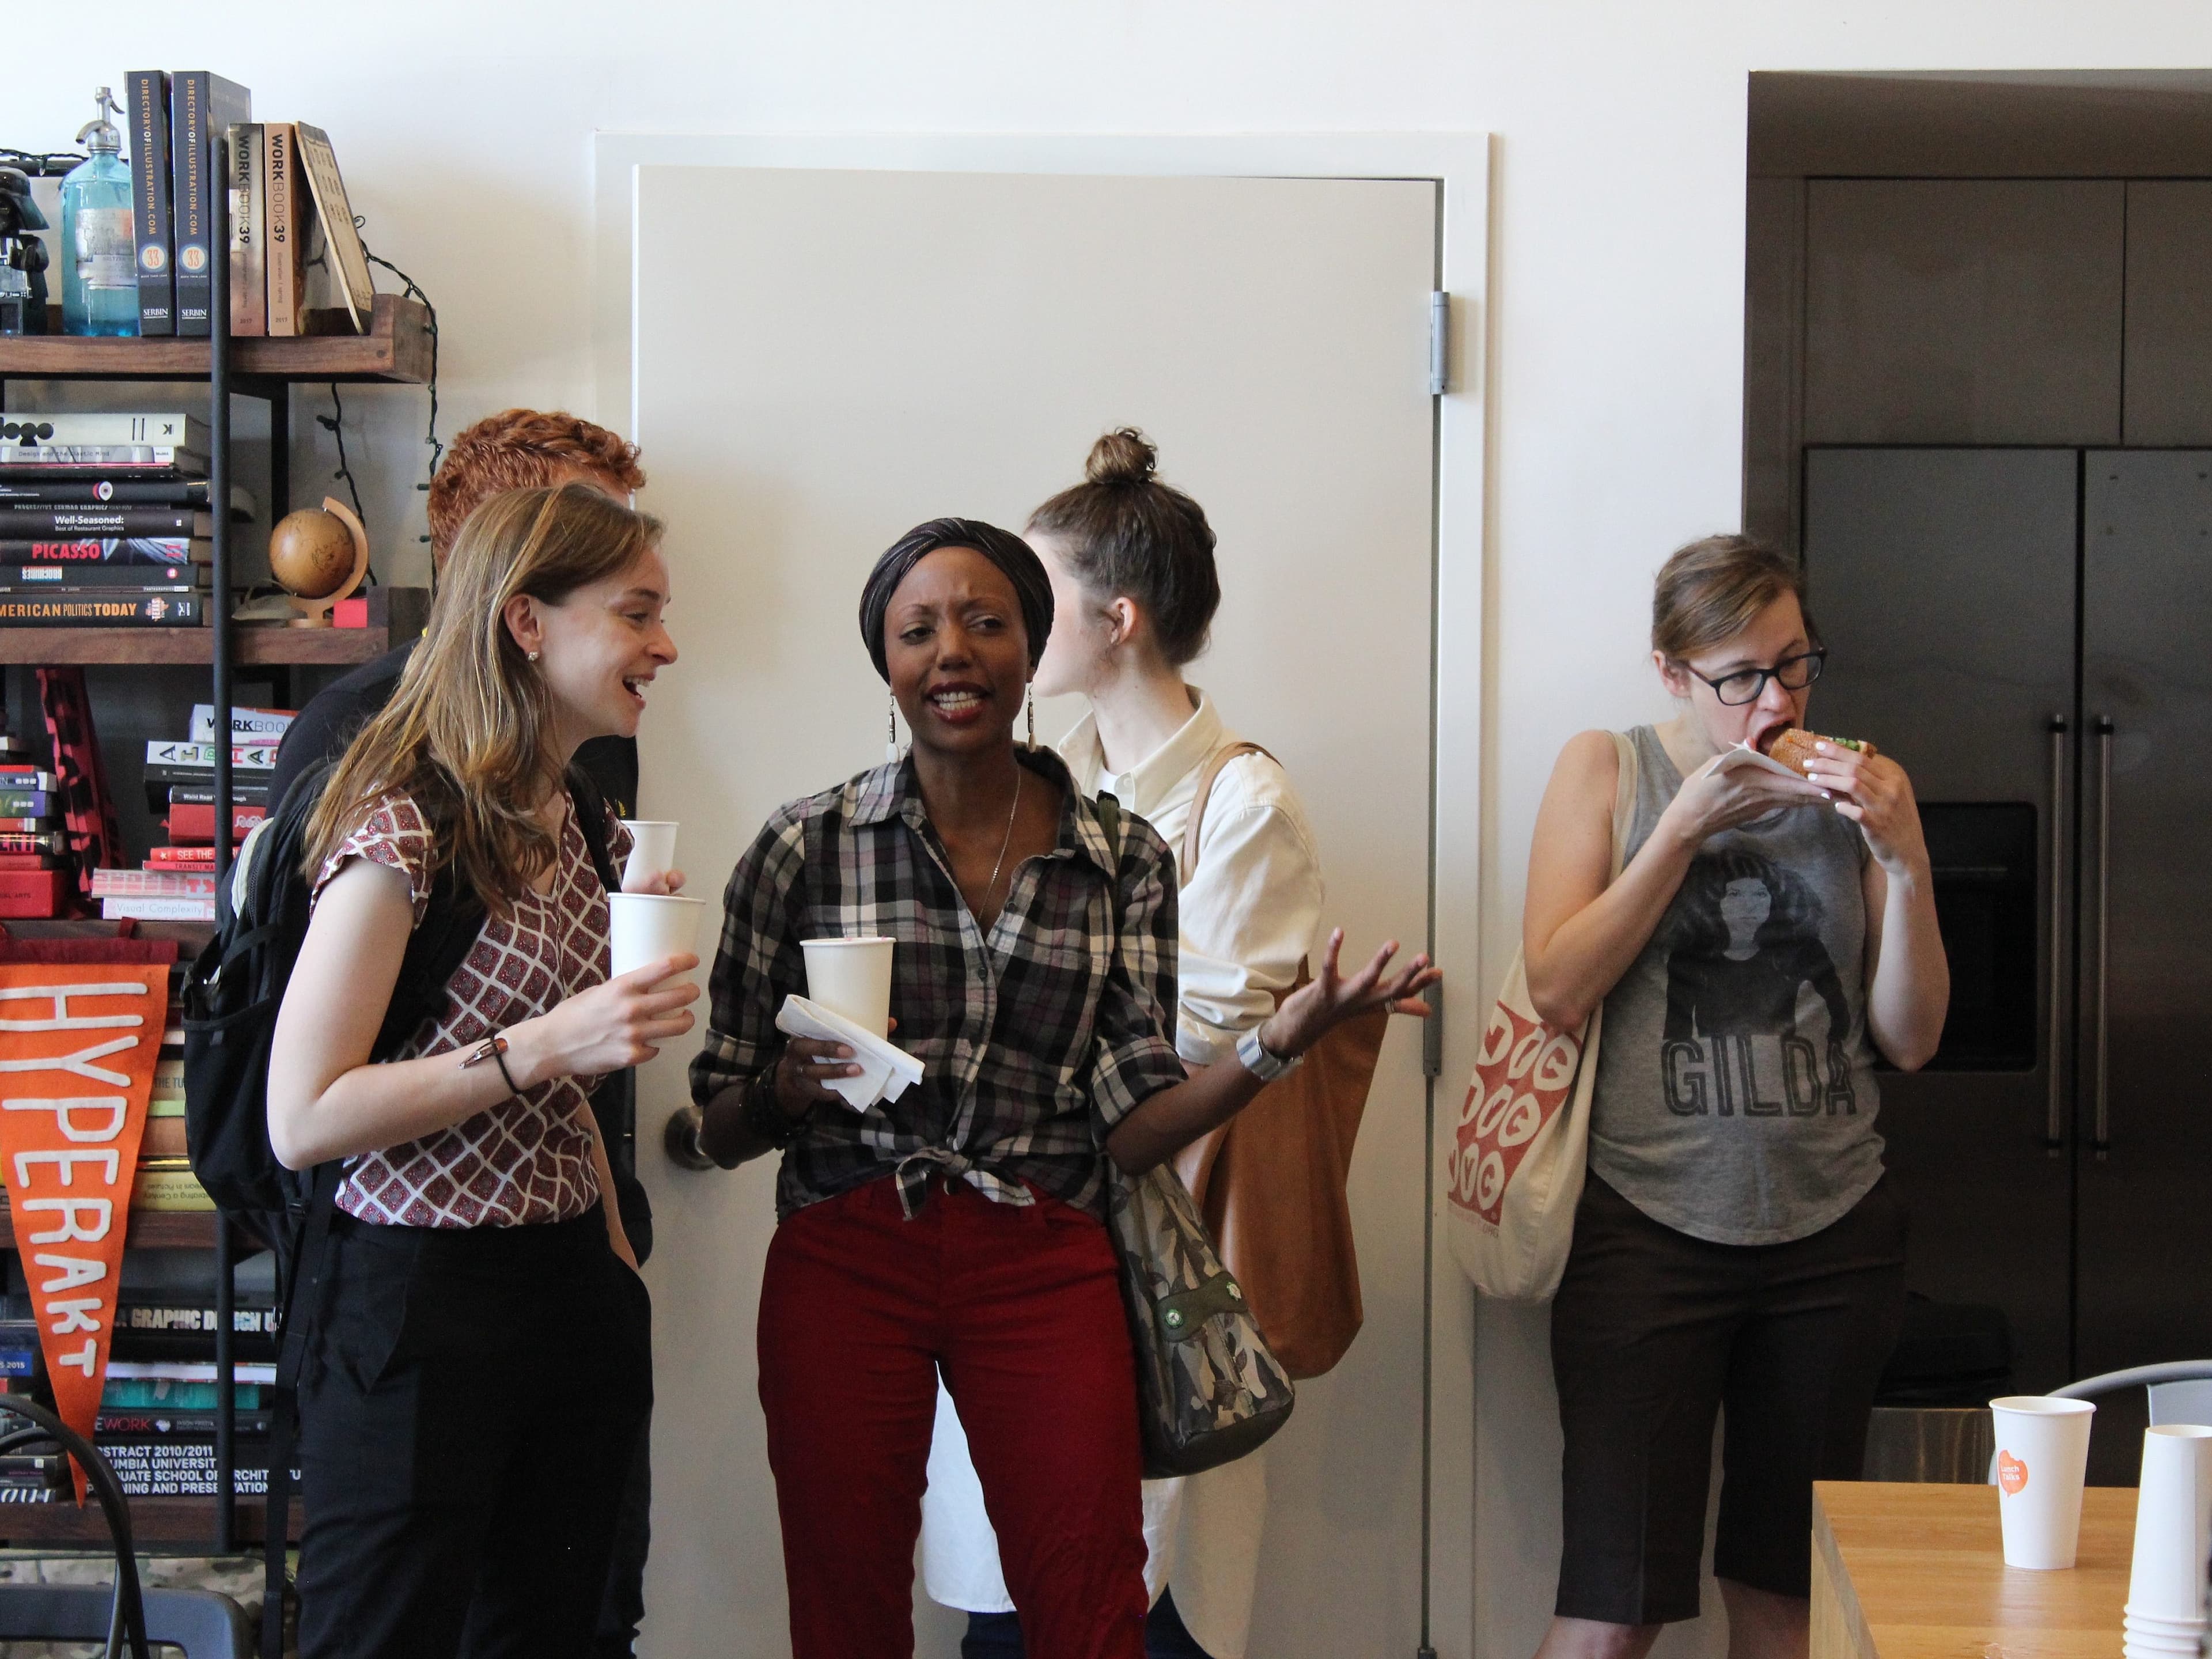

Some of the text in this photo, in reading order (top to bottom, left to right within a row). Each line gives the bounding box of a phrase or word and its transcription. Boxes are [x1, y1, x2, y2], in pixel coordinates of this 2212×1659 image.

[147, 248, 160, 267] 33
[187, 249, 199, 268] 33
[143, 308, 168, 316] SERBIN
[55, 516, 124, 525] Well-Seasoned:
[32, 544, 101, 559] PICASSO
[63, 604, 92, 616] POLITICS
[94, 603, 137, 616] TODAY
[177, 850, 213, 859] SEE THE
[117, 904, 203, 916] Visual Complexity
[1661, 1036, 1857, 1116] GILDA
[0, 982, 148, 1378] HYPERAKT
[131, 1308, 200, 1328] GRAPHIC
[6, 1361, 25, 1369] 2015
[99, 1446, 213, 1457] STRACT 2010/2011
[154, 1469, 203, 1482] SCHOOL
[152, 1483, 179, 1494] AND
